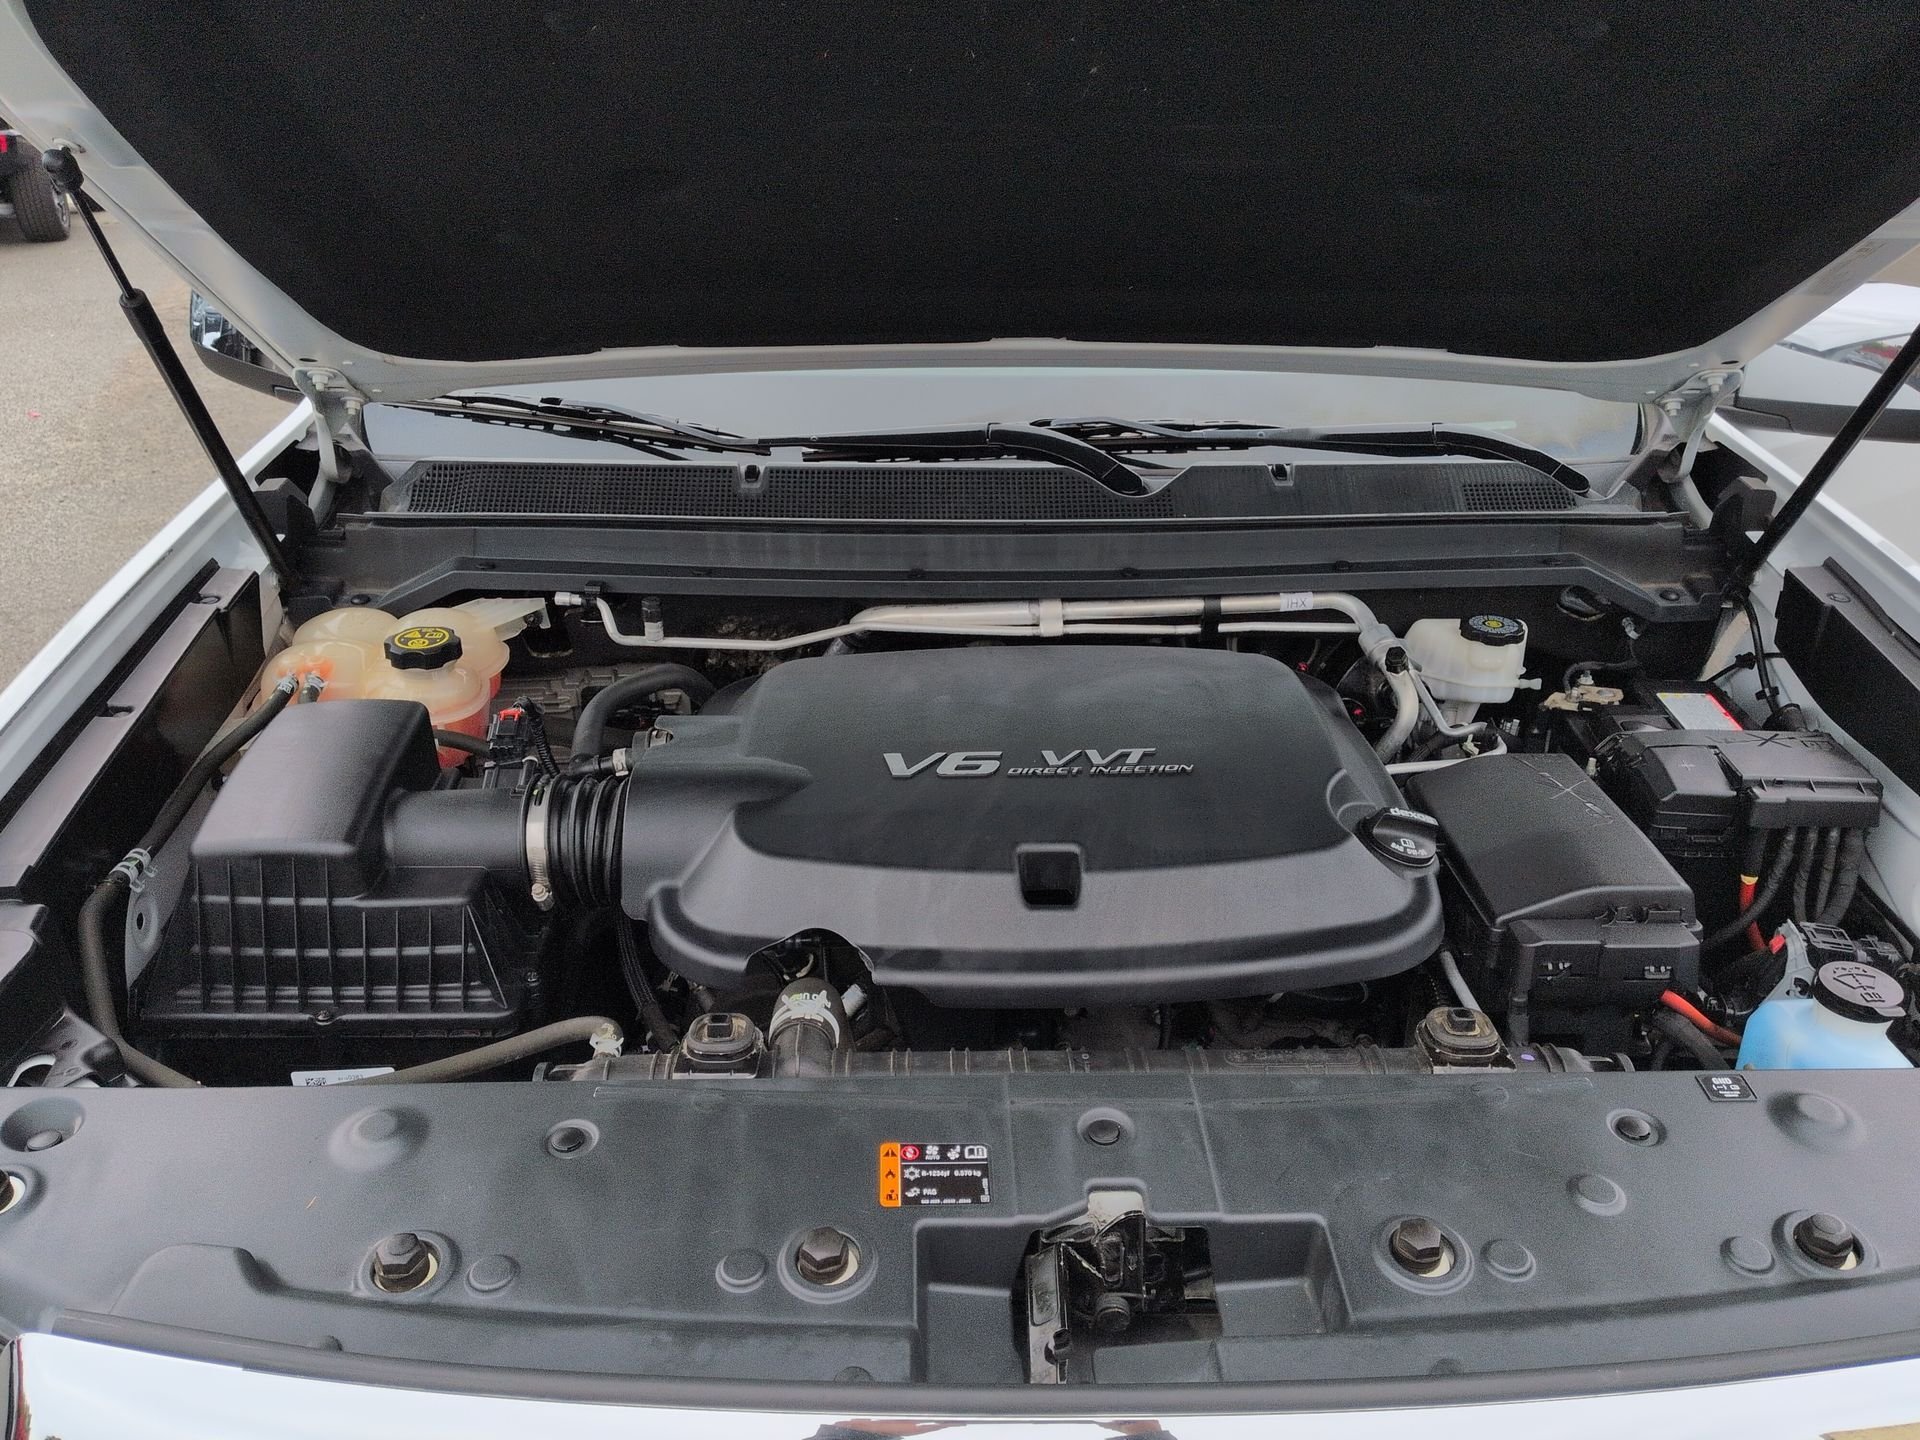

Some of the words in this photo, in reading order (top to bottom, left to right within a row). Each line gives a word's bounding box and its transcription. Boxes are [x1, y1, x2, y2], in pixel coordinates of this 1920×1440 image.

[883, 751, 1003, 778] V6
[1041, 747, 1156, 767] VVT
[1007, 766, 1083, 777] DIRECT
[1089, 763, 1195, 775] INJECTION
